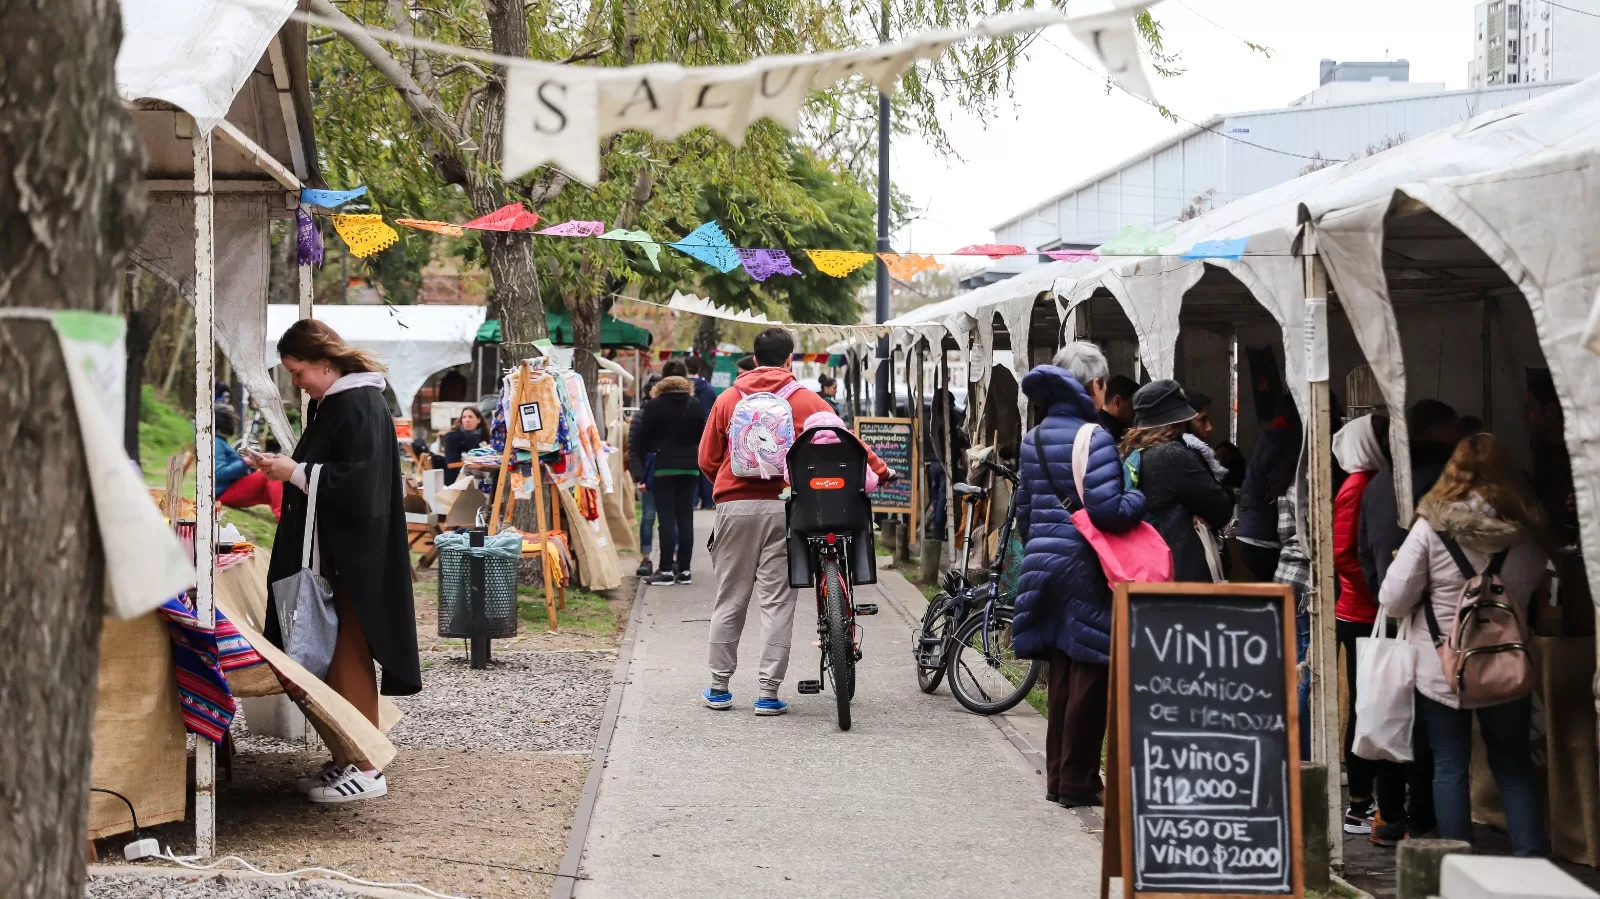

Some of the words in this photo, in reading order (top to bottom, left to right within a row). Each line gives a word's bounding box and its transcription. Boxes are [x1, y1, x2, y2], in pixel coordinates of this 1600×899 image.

[875, 441, 899, 451] gluten
[1144, 622, 1268, 668] VINITO
[1149, 745, 1170, 770] 2
[1146, 818, 1210, 839] VASO
[1213, 821, 1253, 841] DE
[1150, 839, 1210, 866] VINO
[1212, 842, 1280, 874] $2000
